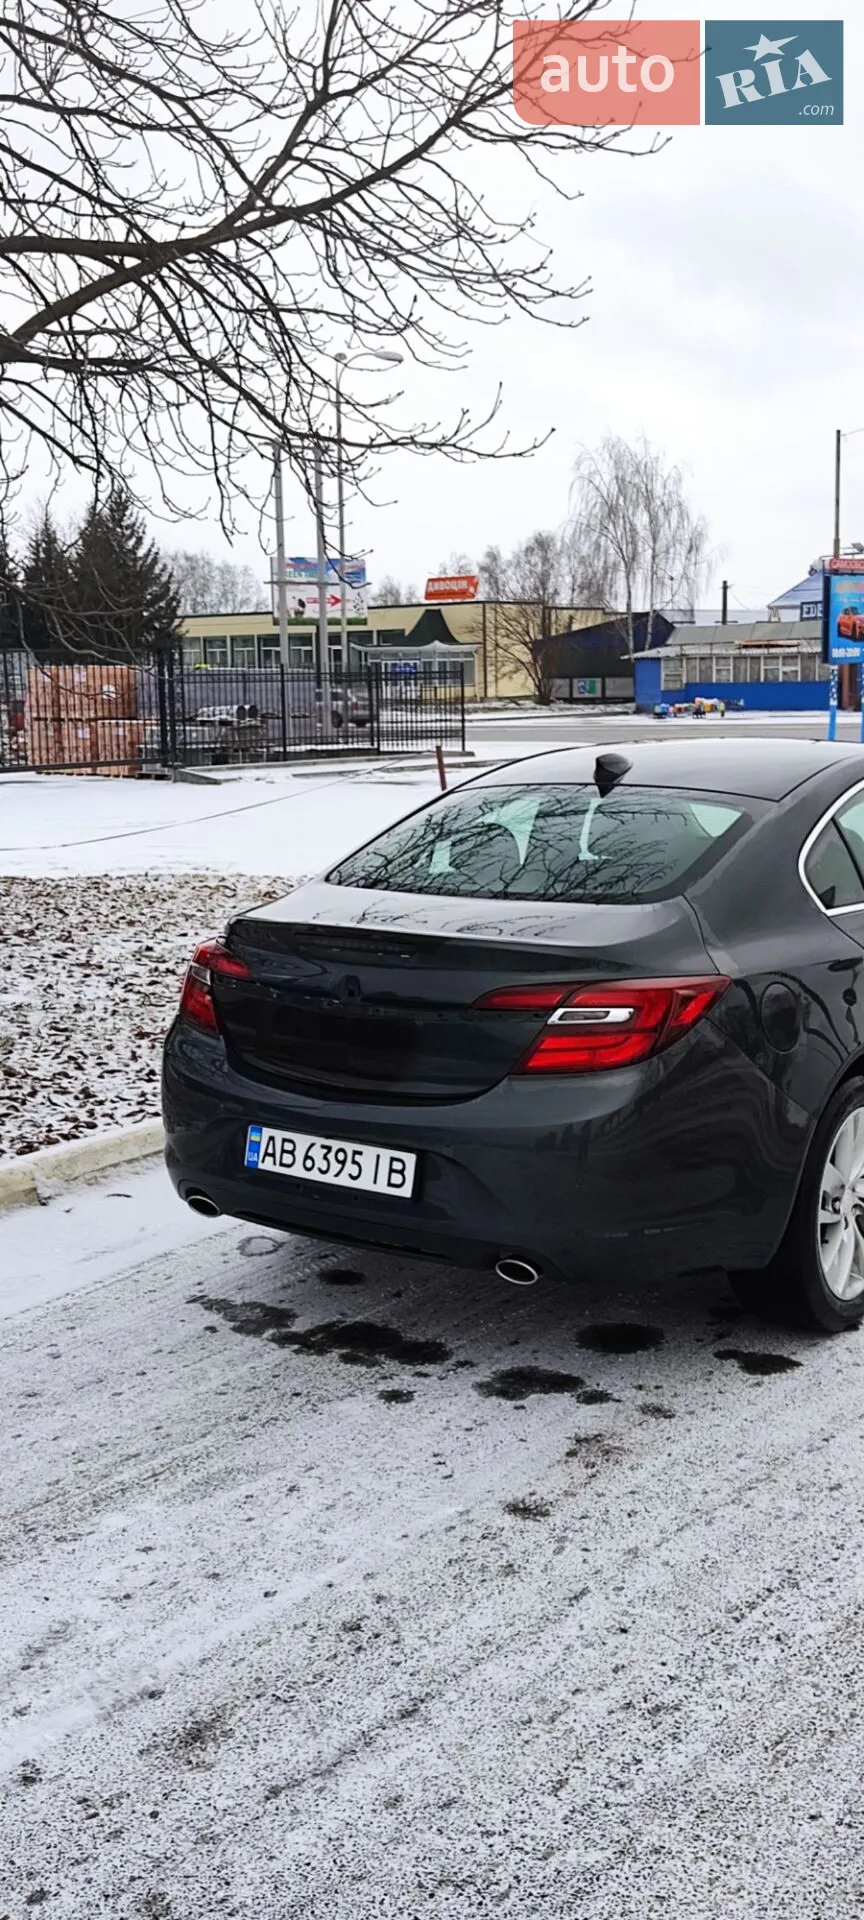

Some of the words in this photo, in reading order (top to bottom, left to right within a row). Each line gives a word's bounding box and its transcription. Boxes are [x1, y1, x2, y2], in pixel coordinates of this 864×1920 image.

[247, 1151, 259, 1162] UA
[261, 1135, 297, 1169] AB
[302, 1142, 364, 1181] 6395
[373, 1153, 407, 1189] IB
